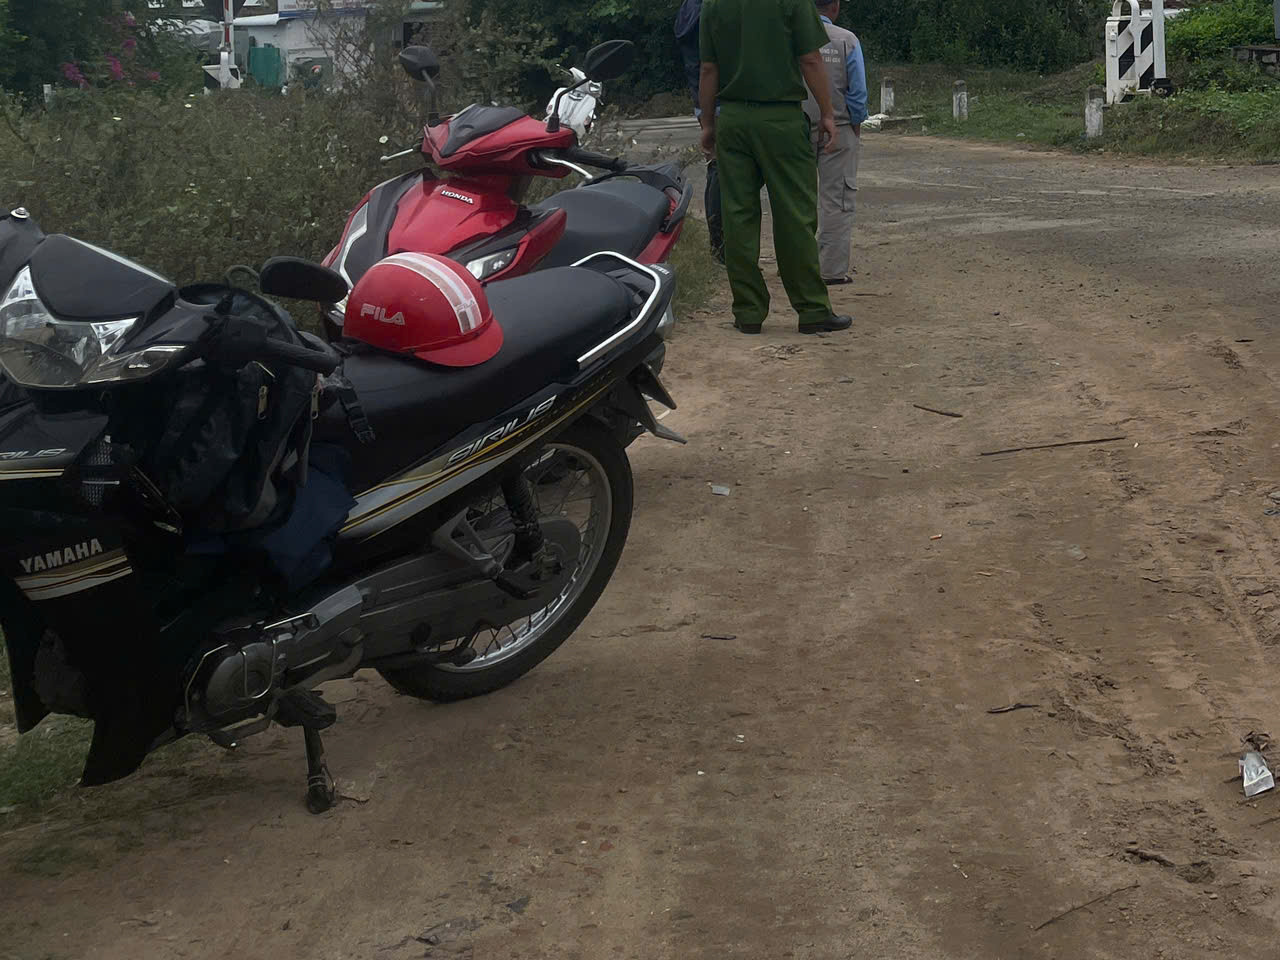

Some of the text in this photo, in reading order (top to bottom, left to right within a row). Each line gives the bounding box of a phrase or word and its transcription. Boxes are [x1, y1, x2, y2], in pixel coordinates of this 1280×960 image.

[441, 190, 474, 205] HONDA
[361, 303, 406, 326] FILA
[446, 394, 558, 464] SIRIUS
[0, 448, 67, 459] RIUS
[20, 538, 103, 573] YAMAHA
